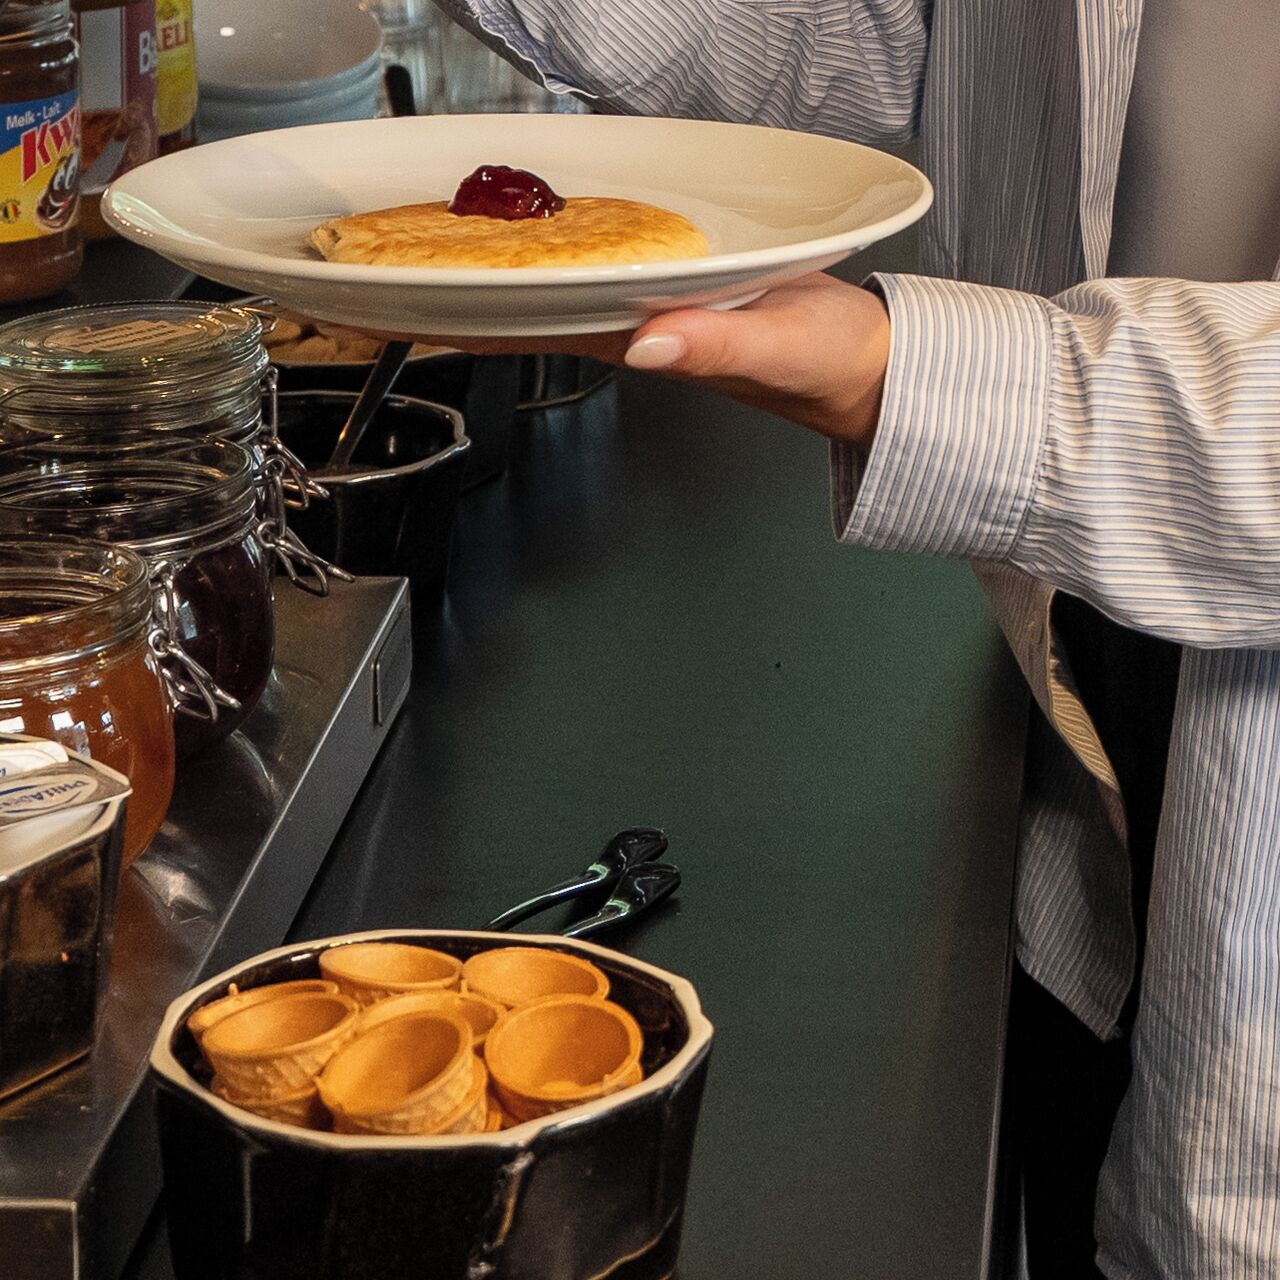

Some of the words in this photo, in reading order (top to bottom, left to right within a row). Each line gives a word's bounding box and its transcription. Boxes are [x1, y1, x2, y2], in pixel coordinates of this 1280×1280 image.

[157, 18, 191, 52] ELI
[6, 110, 35, 131] Melk
[42, 101, 61, 119] Lait
